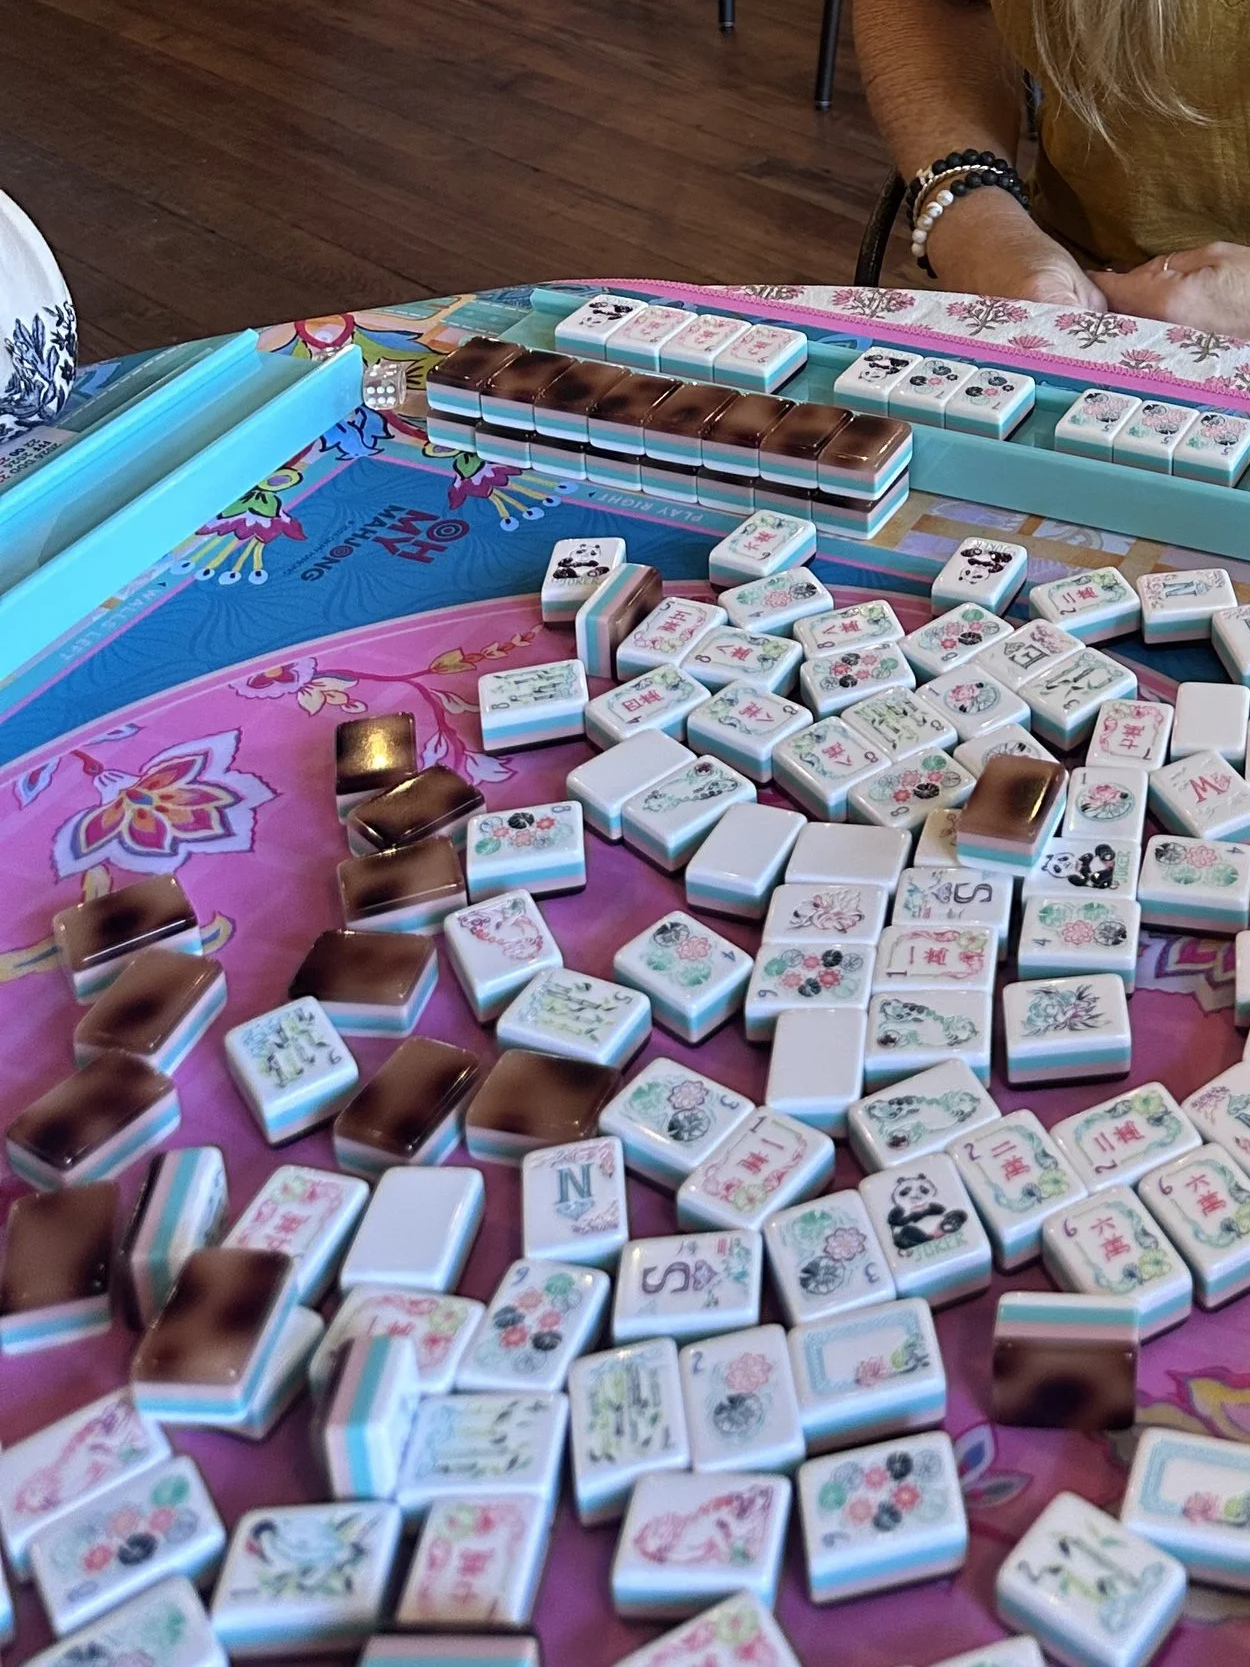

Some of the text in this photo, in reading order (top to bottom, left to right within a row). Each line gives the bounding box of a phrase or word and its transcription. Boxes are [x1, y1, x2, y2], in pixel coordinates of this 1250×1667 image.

[597, 493, 704, 523] PLAY RIGHT
[301, 504, 407, 582] MAHJONG
[1162, 580, 1198, 598] N
[659, 600, 675, 611] 5
[817, 641, 836, 649] 8
[695, 654, 711, 664] 8
[1012, 644, 1049, 670] E
[782, 704, 800, 716] 8
[626, 715, 641, 725] 4
[863, 751, 878, 763] 8
[1139, 748, 1152, 761] 7
[1113, 850, 1130, 885] JOKER
[953, 882, 993, 903] S
[964, 1143, 981, 1160] 2
[1095, 1160, 1118, 1174] 2
[557, 1163, 594, 1202] N
[1159, 1176, 1173, 1195] 6
[1063, 1218, 1077, 1238] 6
[915, 1235, 967, 1263] JOKER
[642, 1265, 691, 1295] S
